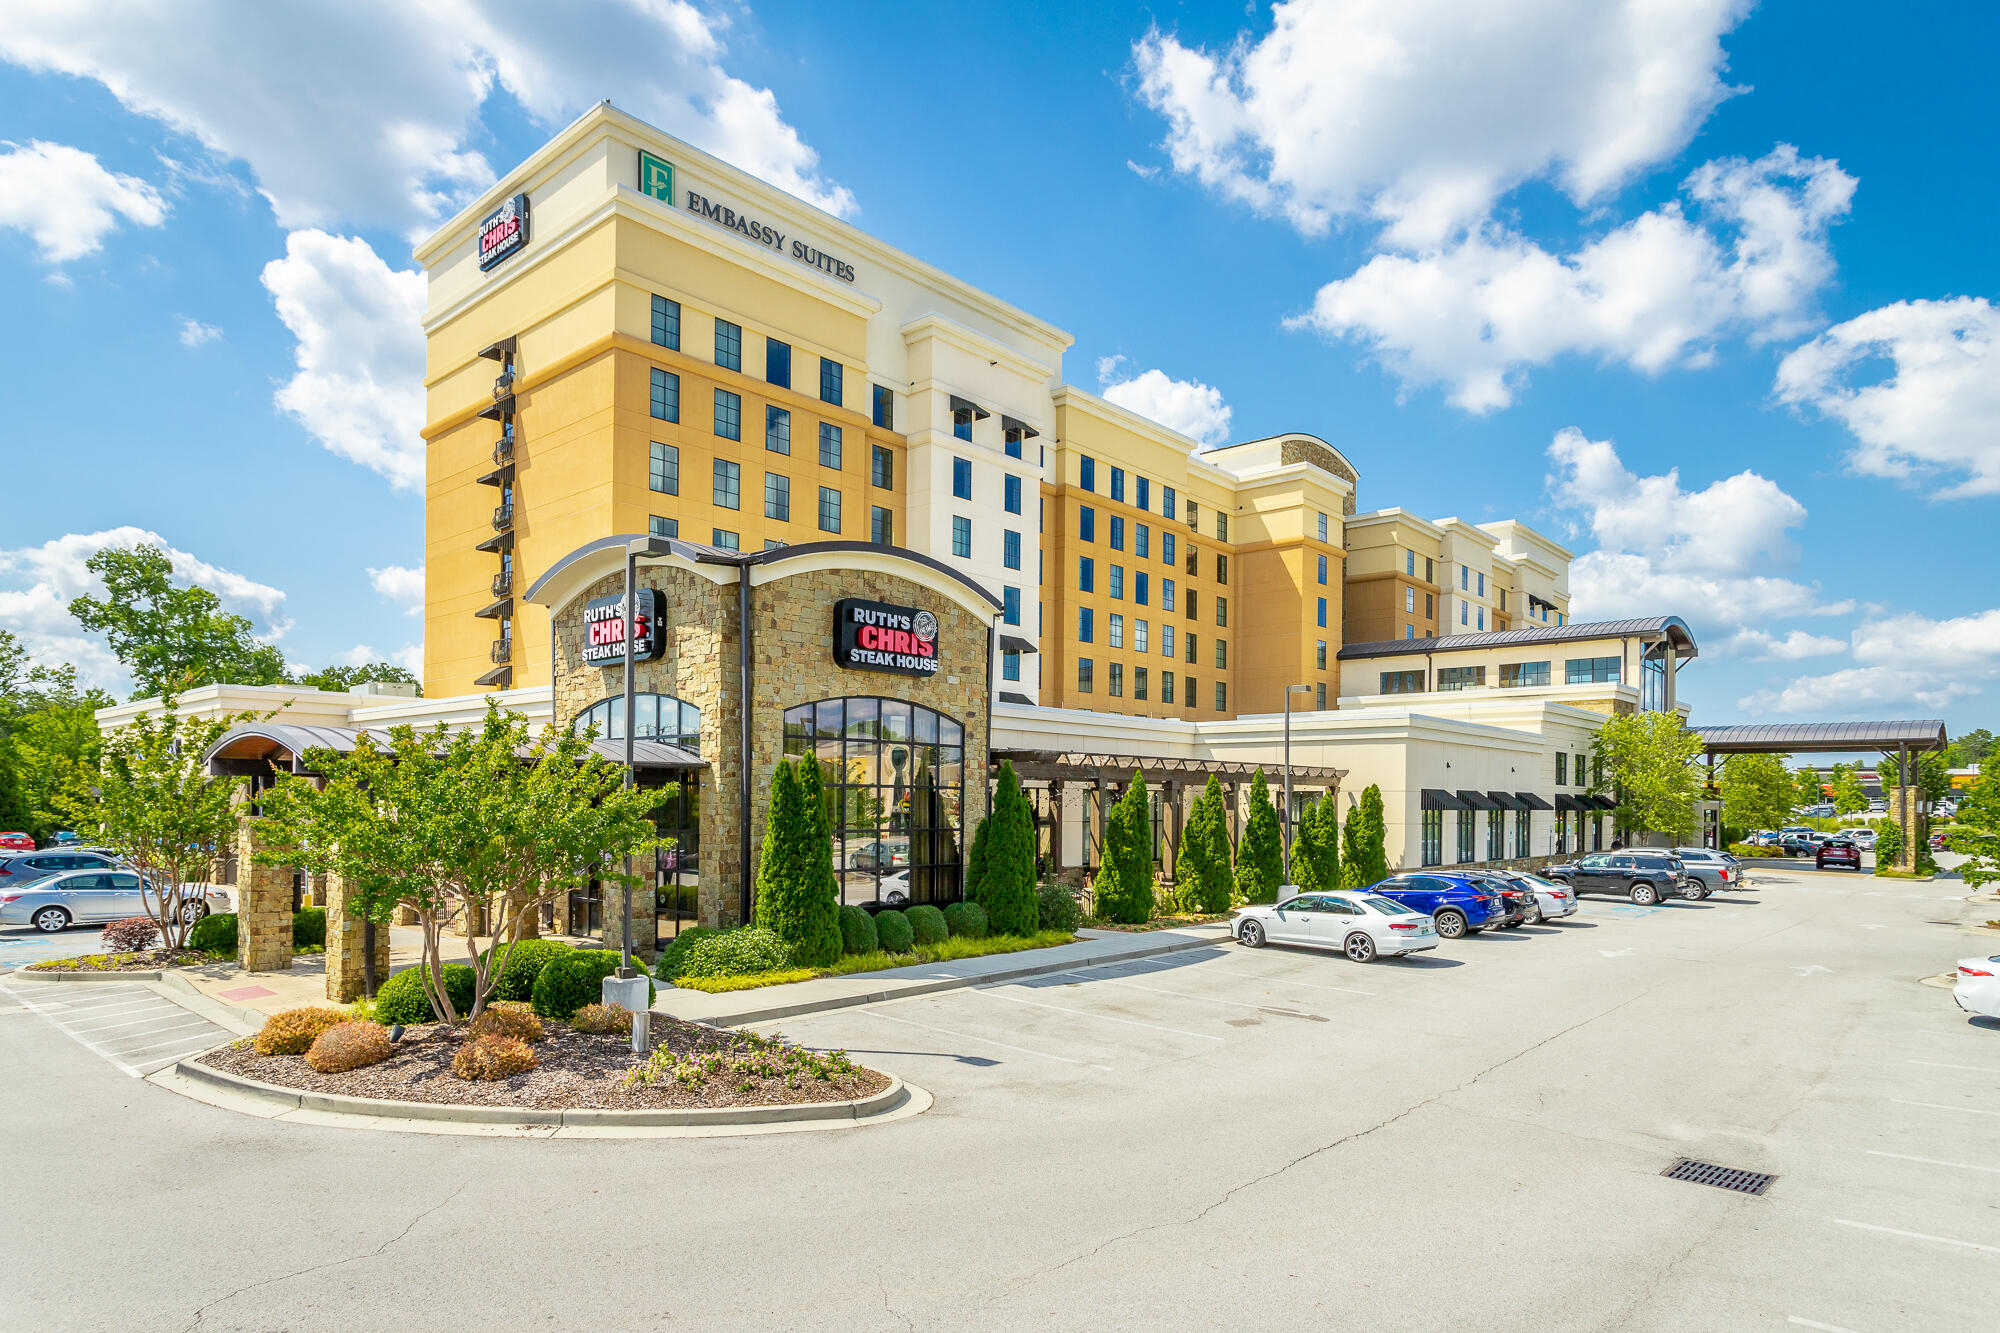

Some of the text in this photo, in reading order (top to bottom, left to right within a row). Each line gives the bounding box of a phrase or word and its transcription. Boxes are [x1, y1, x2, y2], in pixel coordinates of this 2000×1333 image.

[478, 231, 519, 266] STEAK HOUSE
[481, 222, 516, 253] CHRIS
[688, 190, 855, 283] EMBASSY SUITES
[583, 602, 622, 624] RUTH'S
[854, 608, 911, 630] RUTH'S
[589, 615, 641, 646] CHRS
[862, 625, 934, 657] CHRIS
[582, 639, 645, 662] STEAK HOSE
[850, 648, 938, 672] STEAK HOUSE
